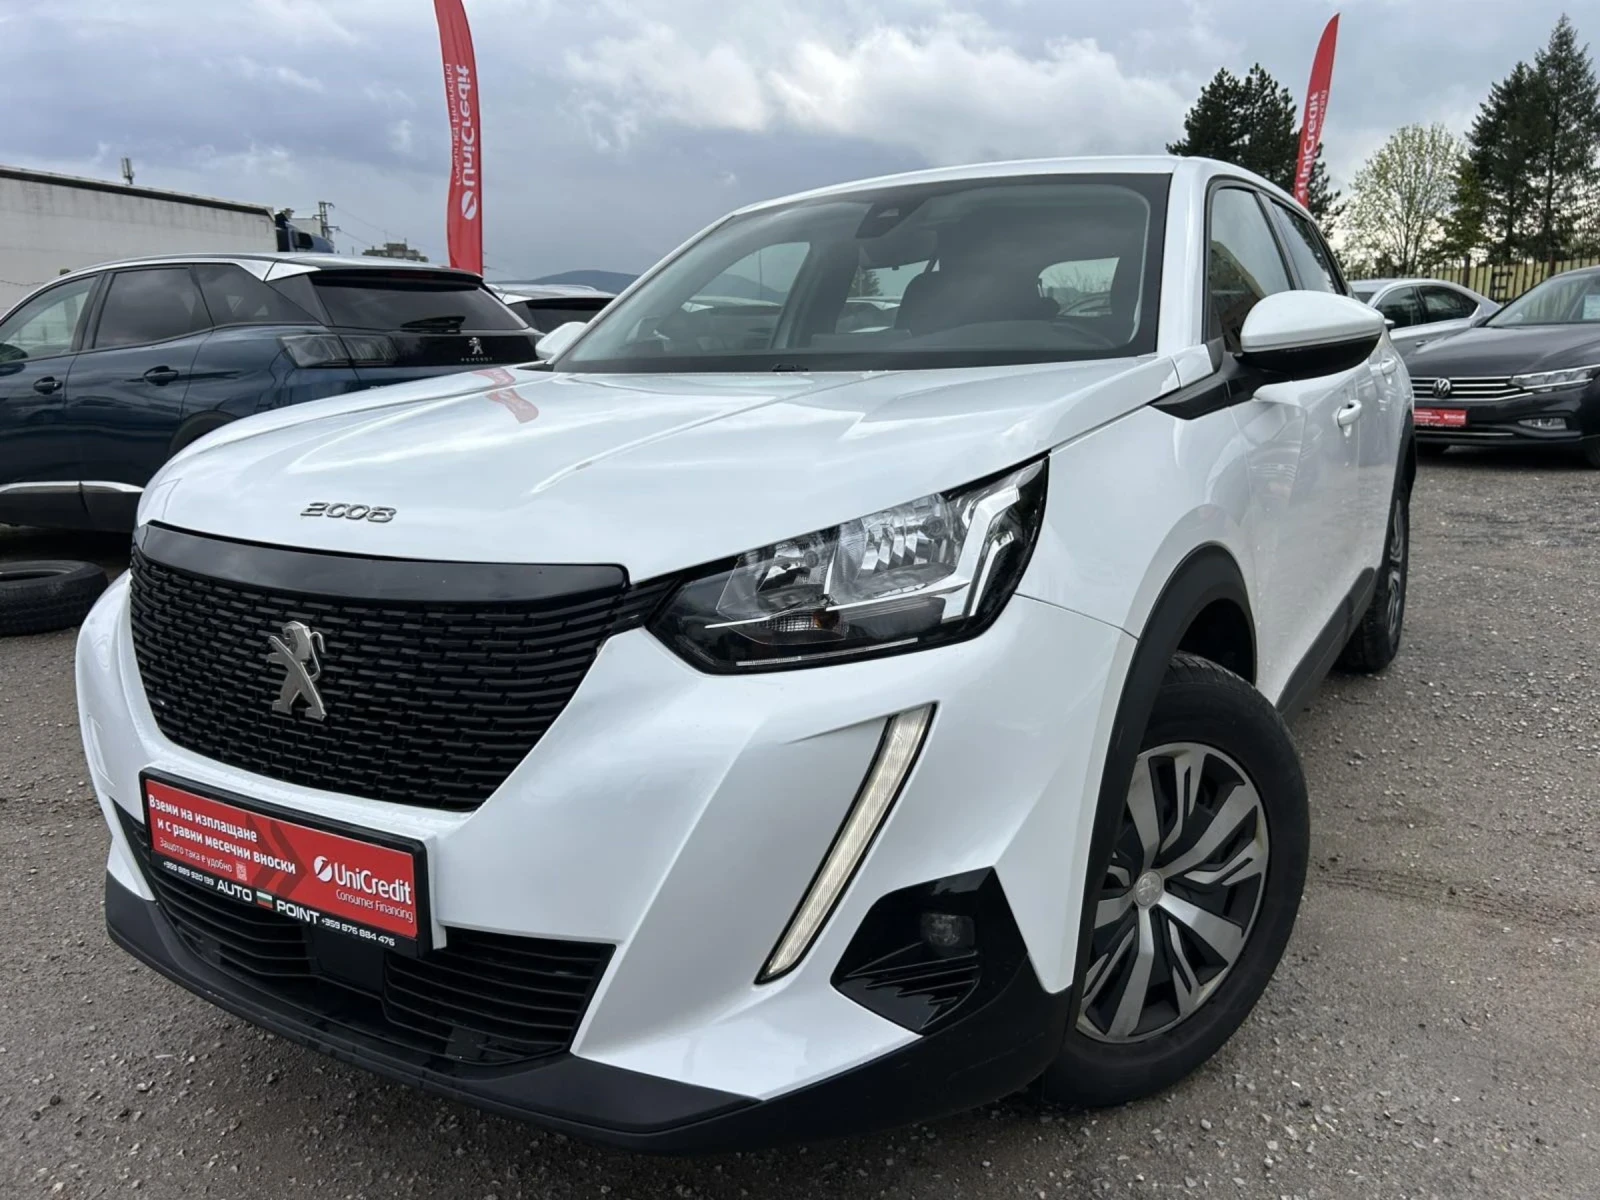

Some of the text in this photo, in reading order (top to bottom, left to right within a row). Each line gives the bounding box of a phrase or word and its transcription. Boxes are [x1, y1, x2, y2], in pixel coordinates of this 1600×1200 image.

[300, 502, 397, 523] 2008
[148, 793, 258, 843] Вземи на изплащане
[157, 818, 296, 875] и с равни месечни вноски
[159, 837, 233, 873] Защото така е удобно
[334, 861, 412, 905] UniCredit
[217, 880, 252, 902] AUTO
[276, 900, 320, 924] POINT
[321, 917, 340, 929] +359
[341, 923, 358, 935] 876
[359, 929, 377, 940] 884
[378, 935, 395, 947] 476
[335, 888, 414, 923] Consumer Financing
